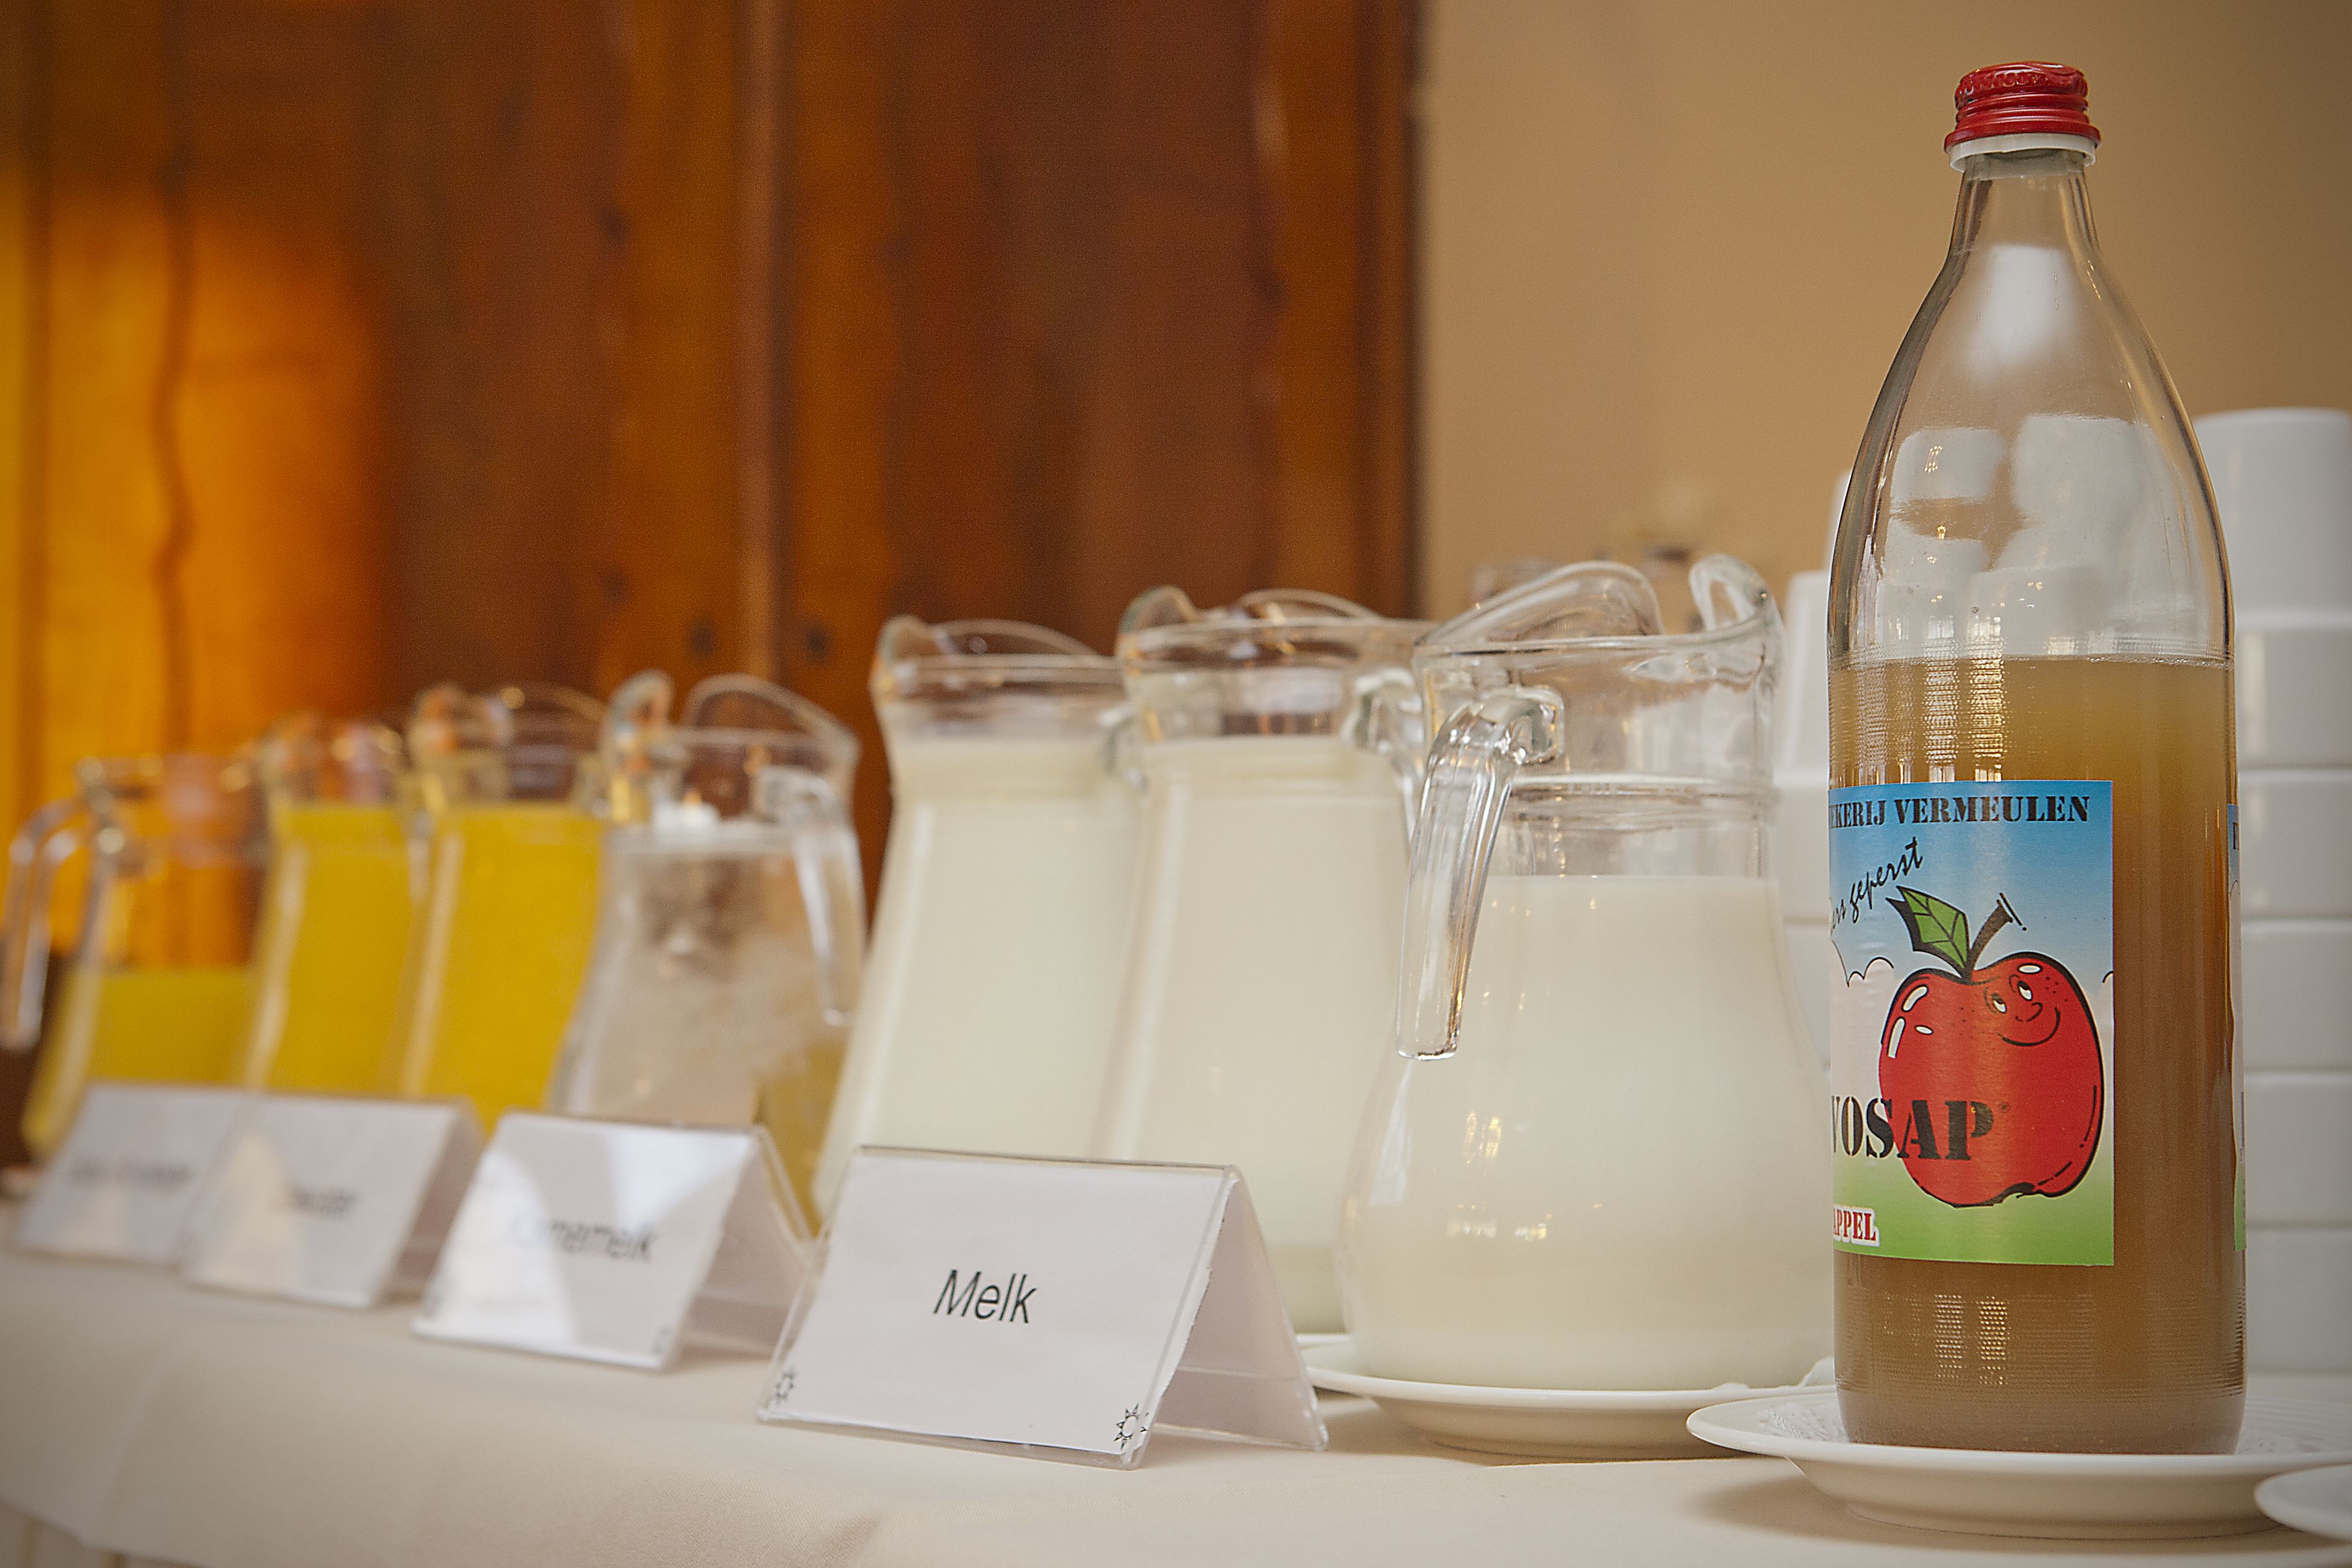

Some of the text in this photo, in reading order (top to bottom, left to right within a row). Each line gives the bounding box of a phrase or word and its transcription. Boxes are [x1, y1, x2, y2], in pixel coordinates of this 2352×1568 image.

[1894, 796, 2090, 824] VERMEULEN
[1850, 836, 1923, 923] geperst
[933, 1268, 1038, 1324] Melk
